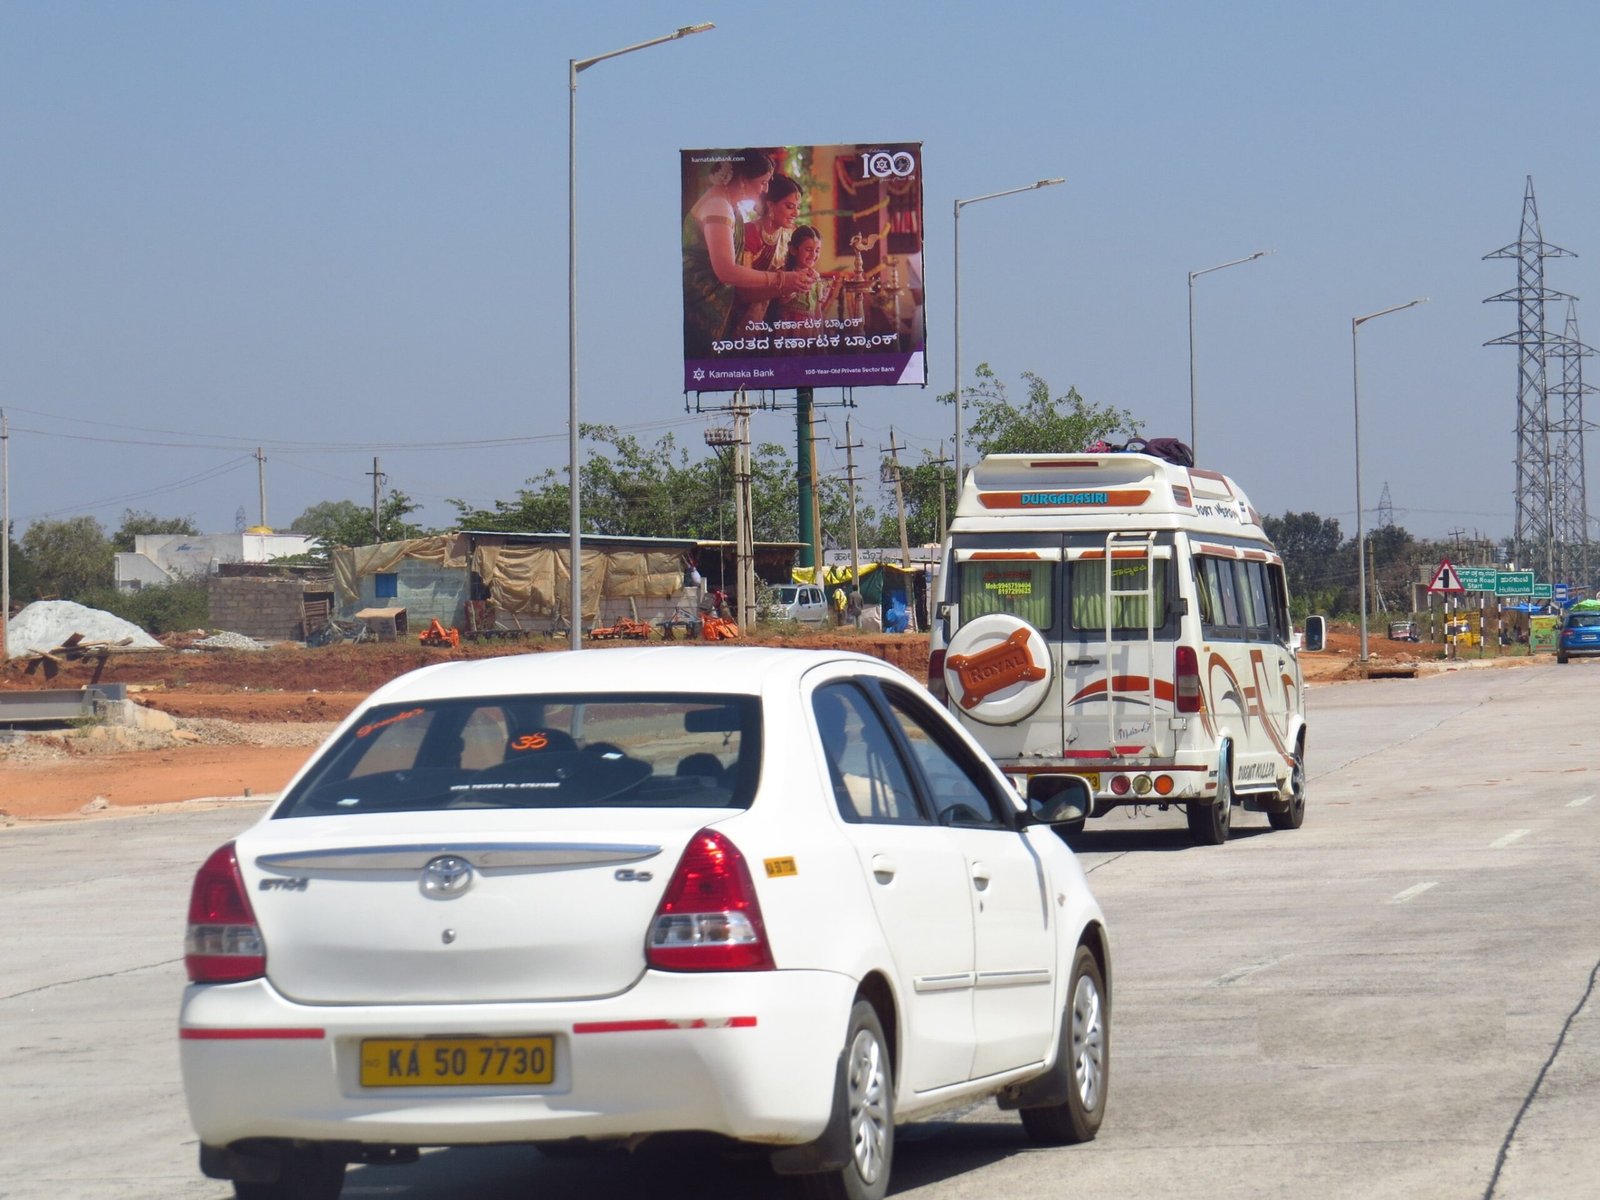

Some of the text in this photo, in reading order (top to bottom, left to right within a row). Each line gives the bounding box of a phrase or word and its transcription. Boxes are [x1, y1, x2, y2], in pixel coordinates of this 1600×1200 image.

[745, 320, 773, 332] ನಿಮ್ಮ
[824, 317, 863, 330] ಬ್ಯಾಂಕ್
[712, 332, 898, 353] ಭಾರತದ ಕರ್ಣಾಟಕ ಬ್ಯಾಂಕ್
[709, 369, 775, 378] Karnataka Bank
[1021, 493, 1109, 505] DURGADASIRI
[1479, 576, 1495, 584] Road
[969, 655, 1025, 685] ROYAL
[389, 1048, 420, 1077] KA
[434, 1048, 467, 1076] 50
[479, 1047, 545, 1075] 7730
